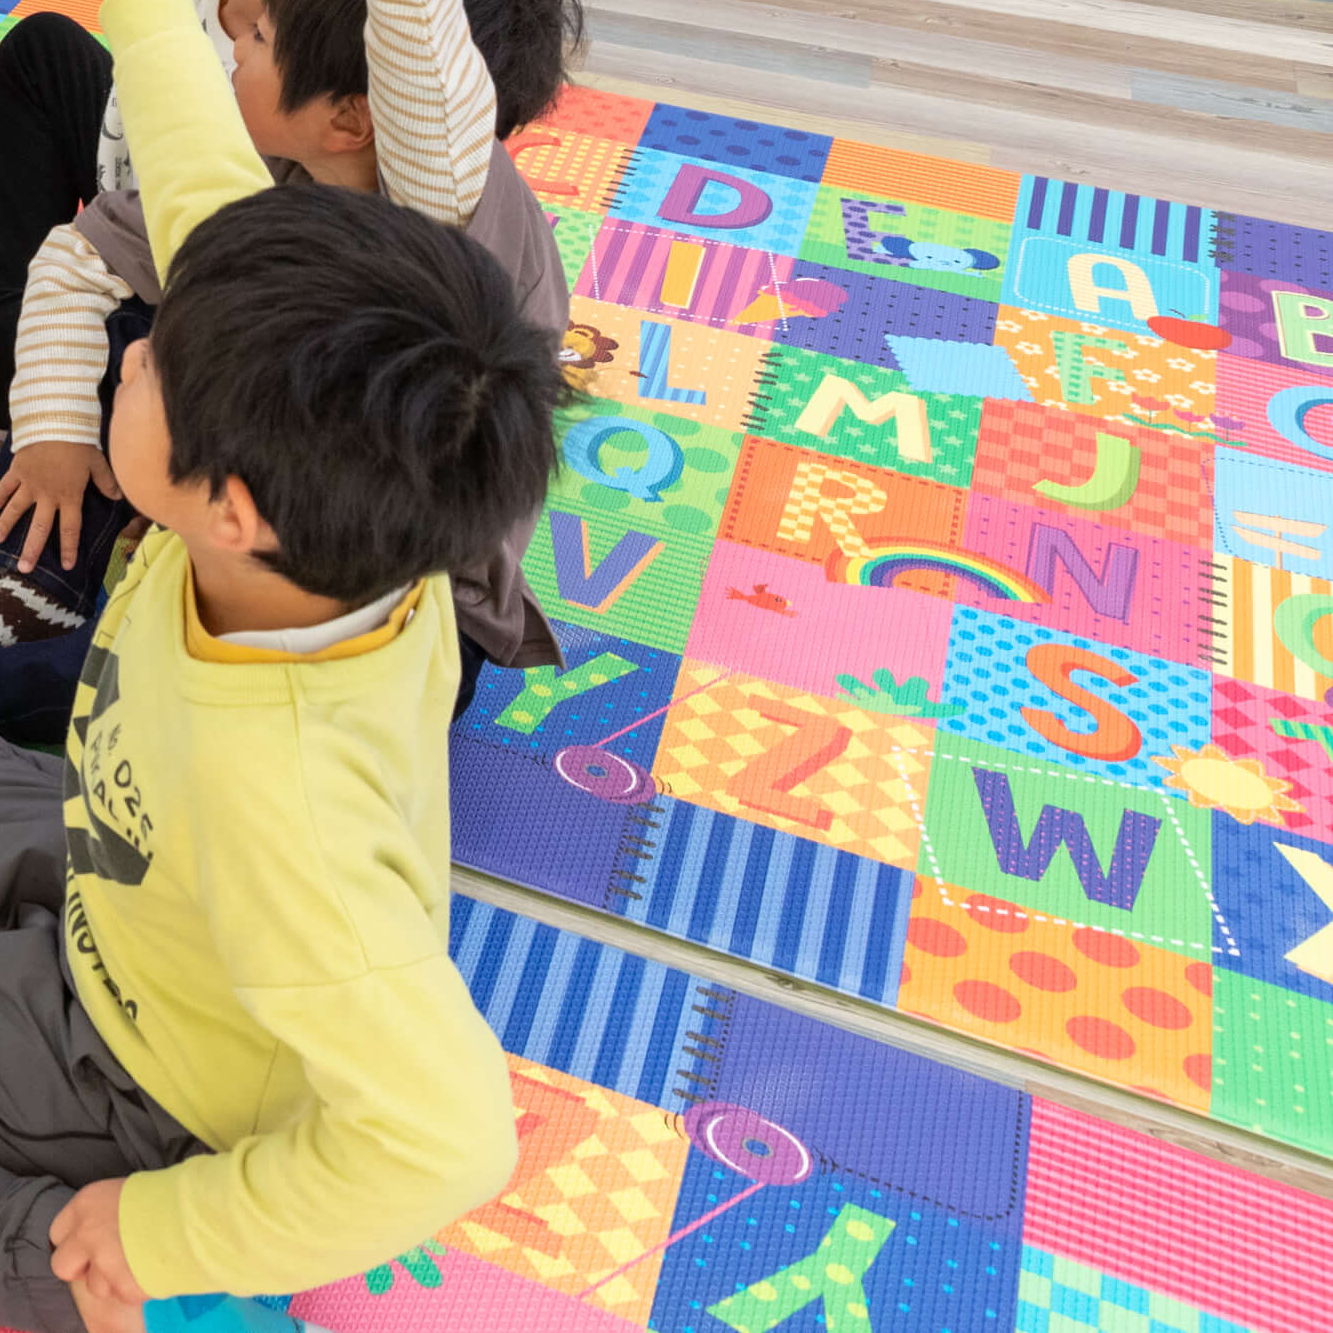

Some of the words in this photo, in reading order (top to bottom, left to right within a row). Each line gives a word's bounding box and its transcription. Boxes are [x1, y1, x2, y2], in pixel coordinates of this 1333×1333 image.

[656, 162, 773, 229] D
[1067, 253, 1160, 321] A
[638, 320, 707, 406] L
[1052, 329, 1129, 406] F
[563, 414, 685, 503] Q
[794, 374, 934, 463] M
[777, 462, 889, 558] R
[1032, 431, 1141, 511] J
[549, 510, 665, 615] V
[1026, 521, 1139, 625] N
[1020, 642, 1143, 762] S
[971, 765, 1162, 914] W
